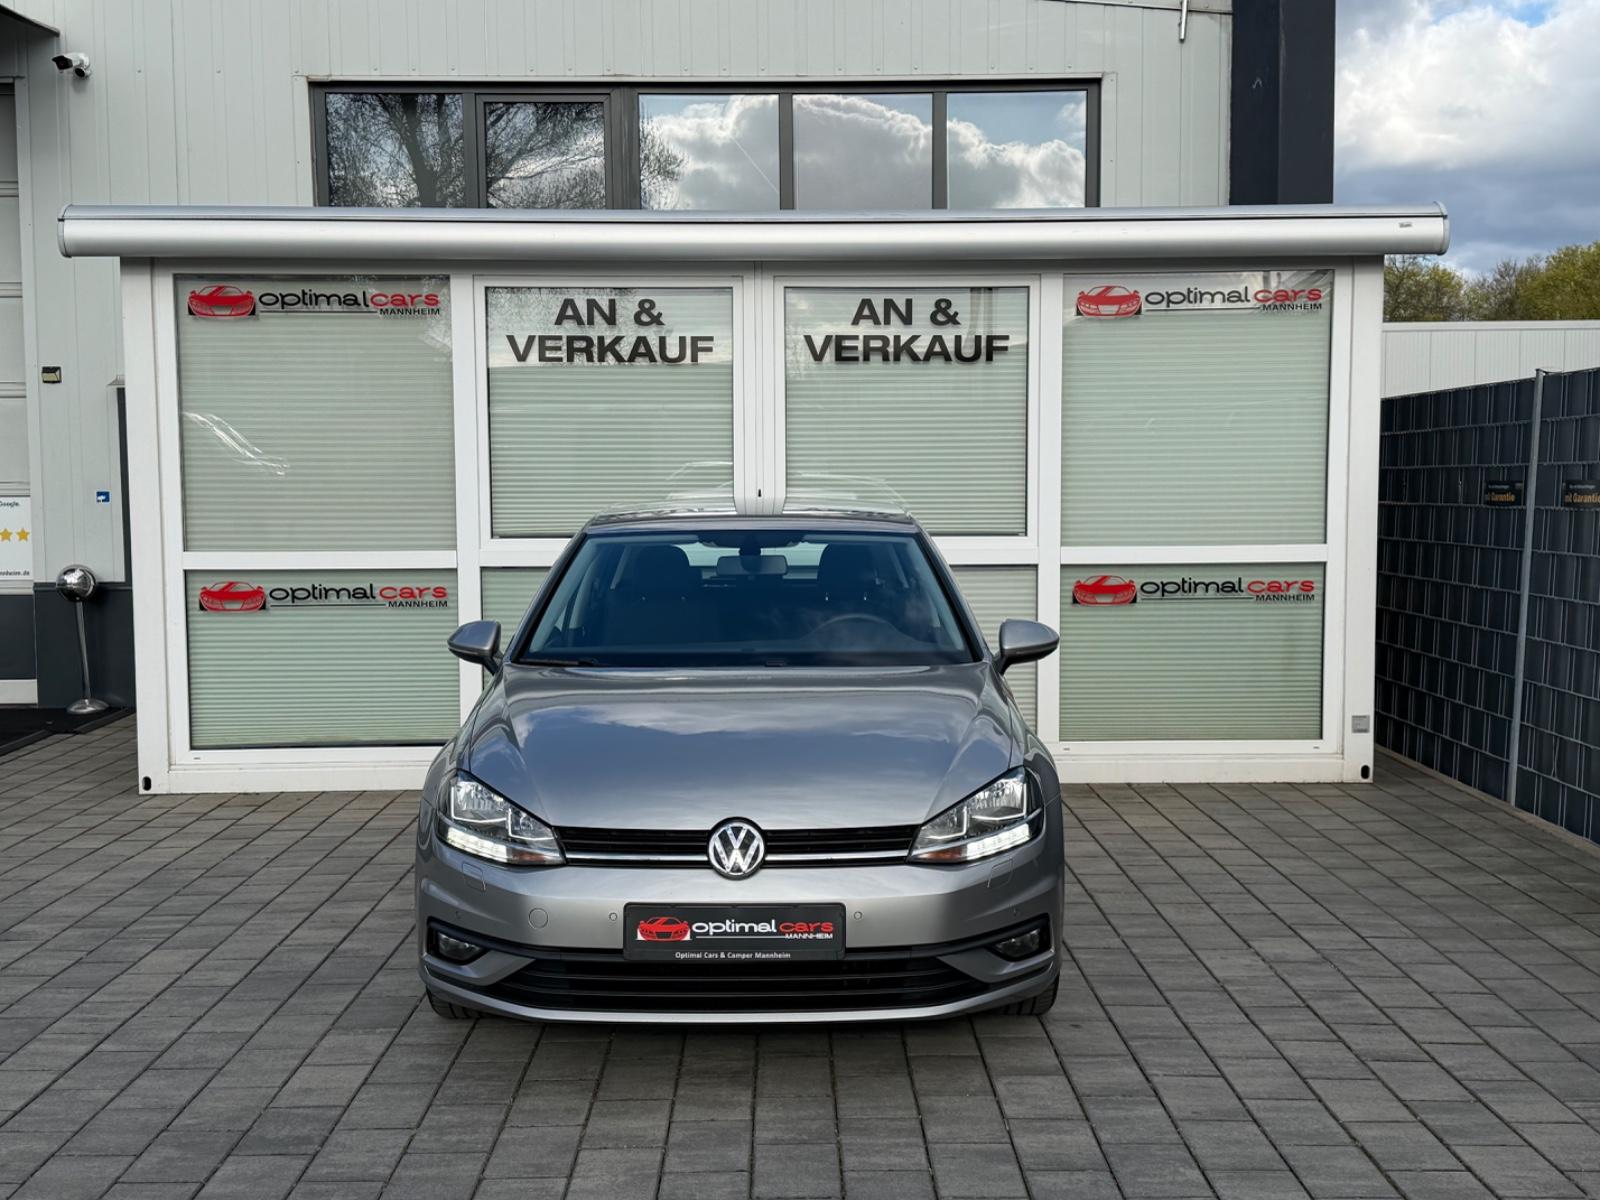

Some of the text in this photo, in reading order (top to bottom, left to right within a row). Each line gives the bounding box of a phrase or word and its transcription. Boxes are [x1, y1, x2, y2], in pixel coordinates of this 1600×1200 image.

[1254, 288, 1322, 302] cars
[554, 298, 665, 326] AN &
[851, 298, 962, 326] AN &
[1262, 303, 1322, 311] MANNHEIM
[505, 335, 714, 363] VERKAUF
[803, 334, 1010, 362] VERKAUF
[268, 583, 448, 603] optimal cars
[1140, 577, 1315, 597] optimal cars
[692, 919, 834, 935] optimal cars
[675, 951, 791, 960] Optimal Cars & Camper Mannheim
